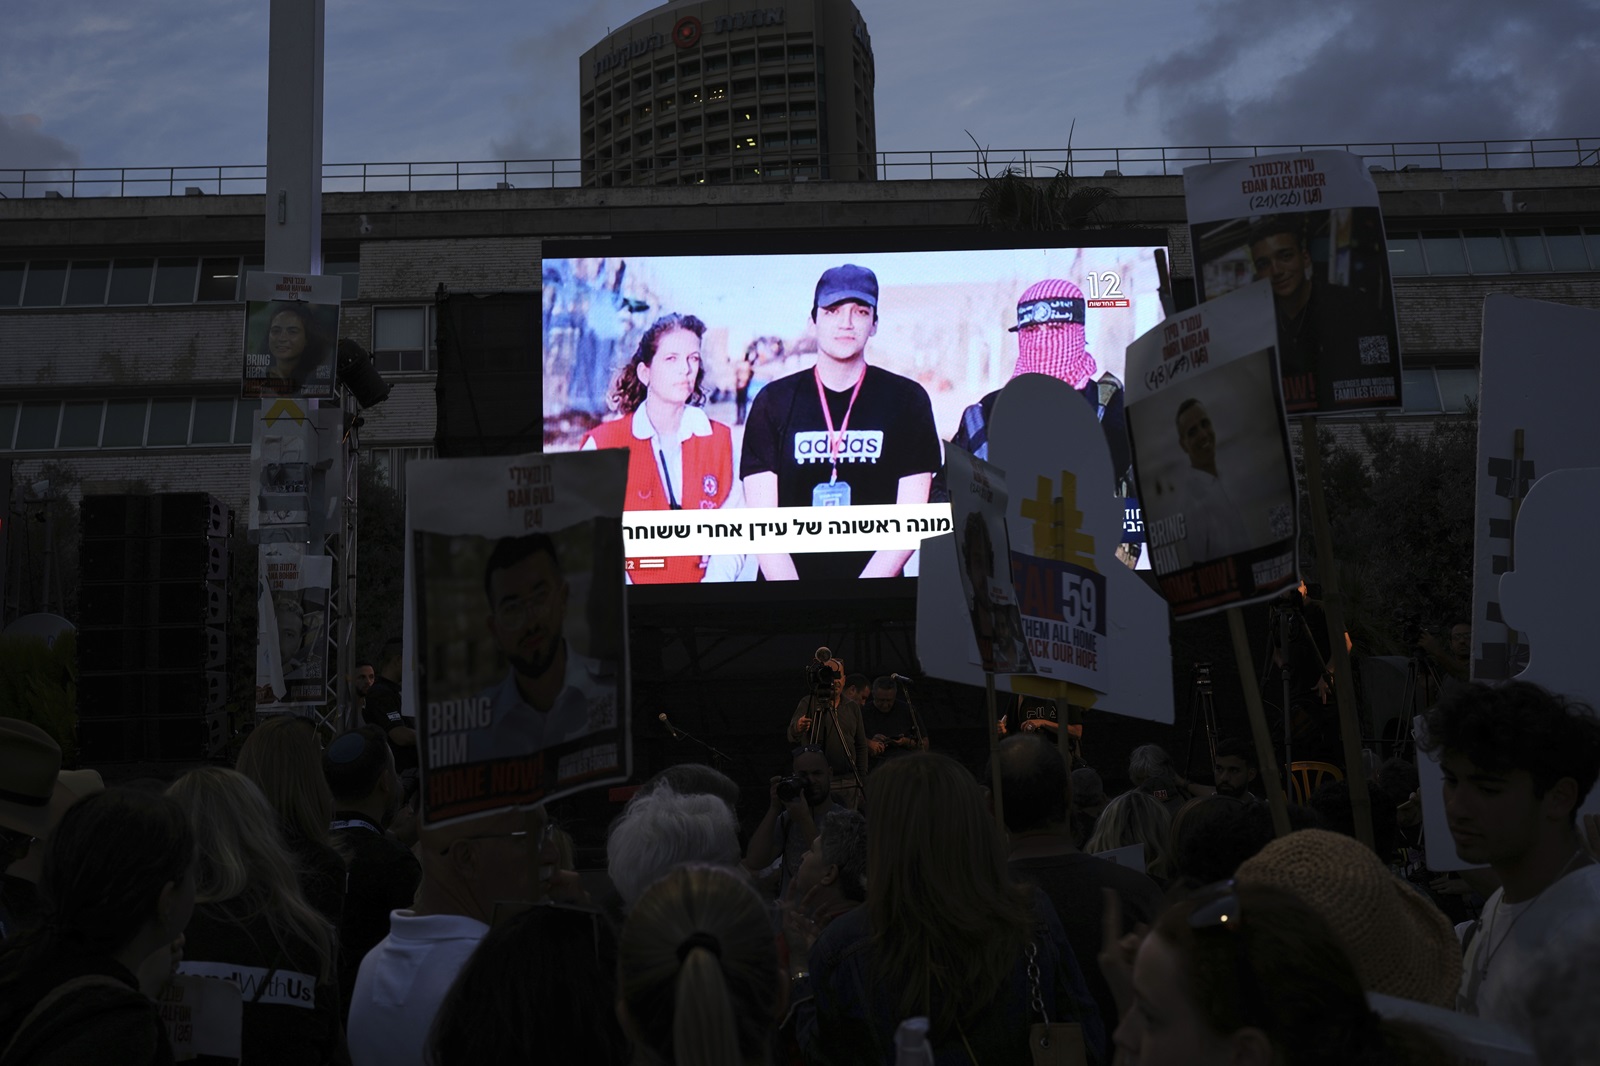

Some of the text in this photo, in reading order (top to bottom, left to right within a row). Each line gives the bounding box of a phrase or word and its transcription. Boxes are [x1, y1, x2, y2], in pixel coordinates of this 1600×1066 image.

[1242, 172, 1326, 194] EDAN ALEXANDER
[1087, 271, 1125, 299] 12
[246, 354, 271, 366] BRING
[1334, 383, 1396, 401] FAMILIES FORUM
[508, 488, 531, 508] RAN
[696, 523, 743, 538] אחרי
[749, 521, 788, 541] עידן
[793, 518, 822, 536] של
[828, 519, 901, 535] ראשונה
[907, 517, 954, 532] מונה
[1149, 513, 1187, 548] BRING
[1153, 543, 1181, 577] HIM
[1062, 571, 1097, 632] 59
[1052, 623, 1071, 646] ALL
[1073, 627, 1097, 653] HOME
[1052, 642, 1074, 666] OUR
[1075, 648, 1098, 673] HOPE
[428, 697, 493, 735] BRING
[428, 733, 468, 770] HIM
[430, 764, 486, 808] HOME
[490, 751, 545, 794] NOW!
